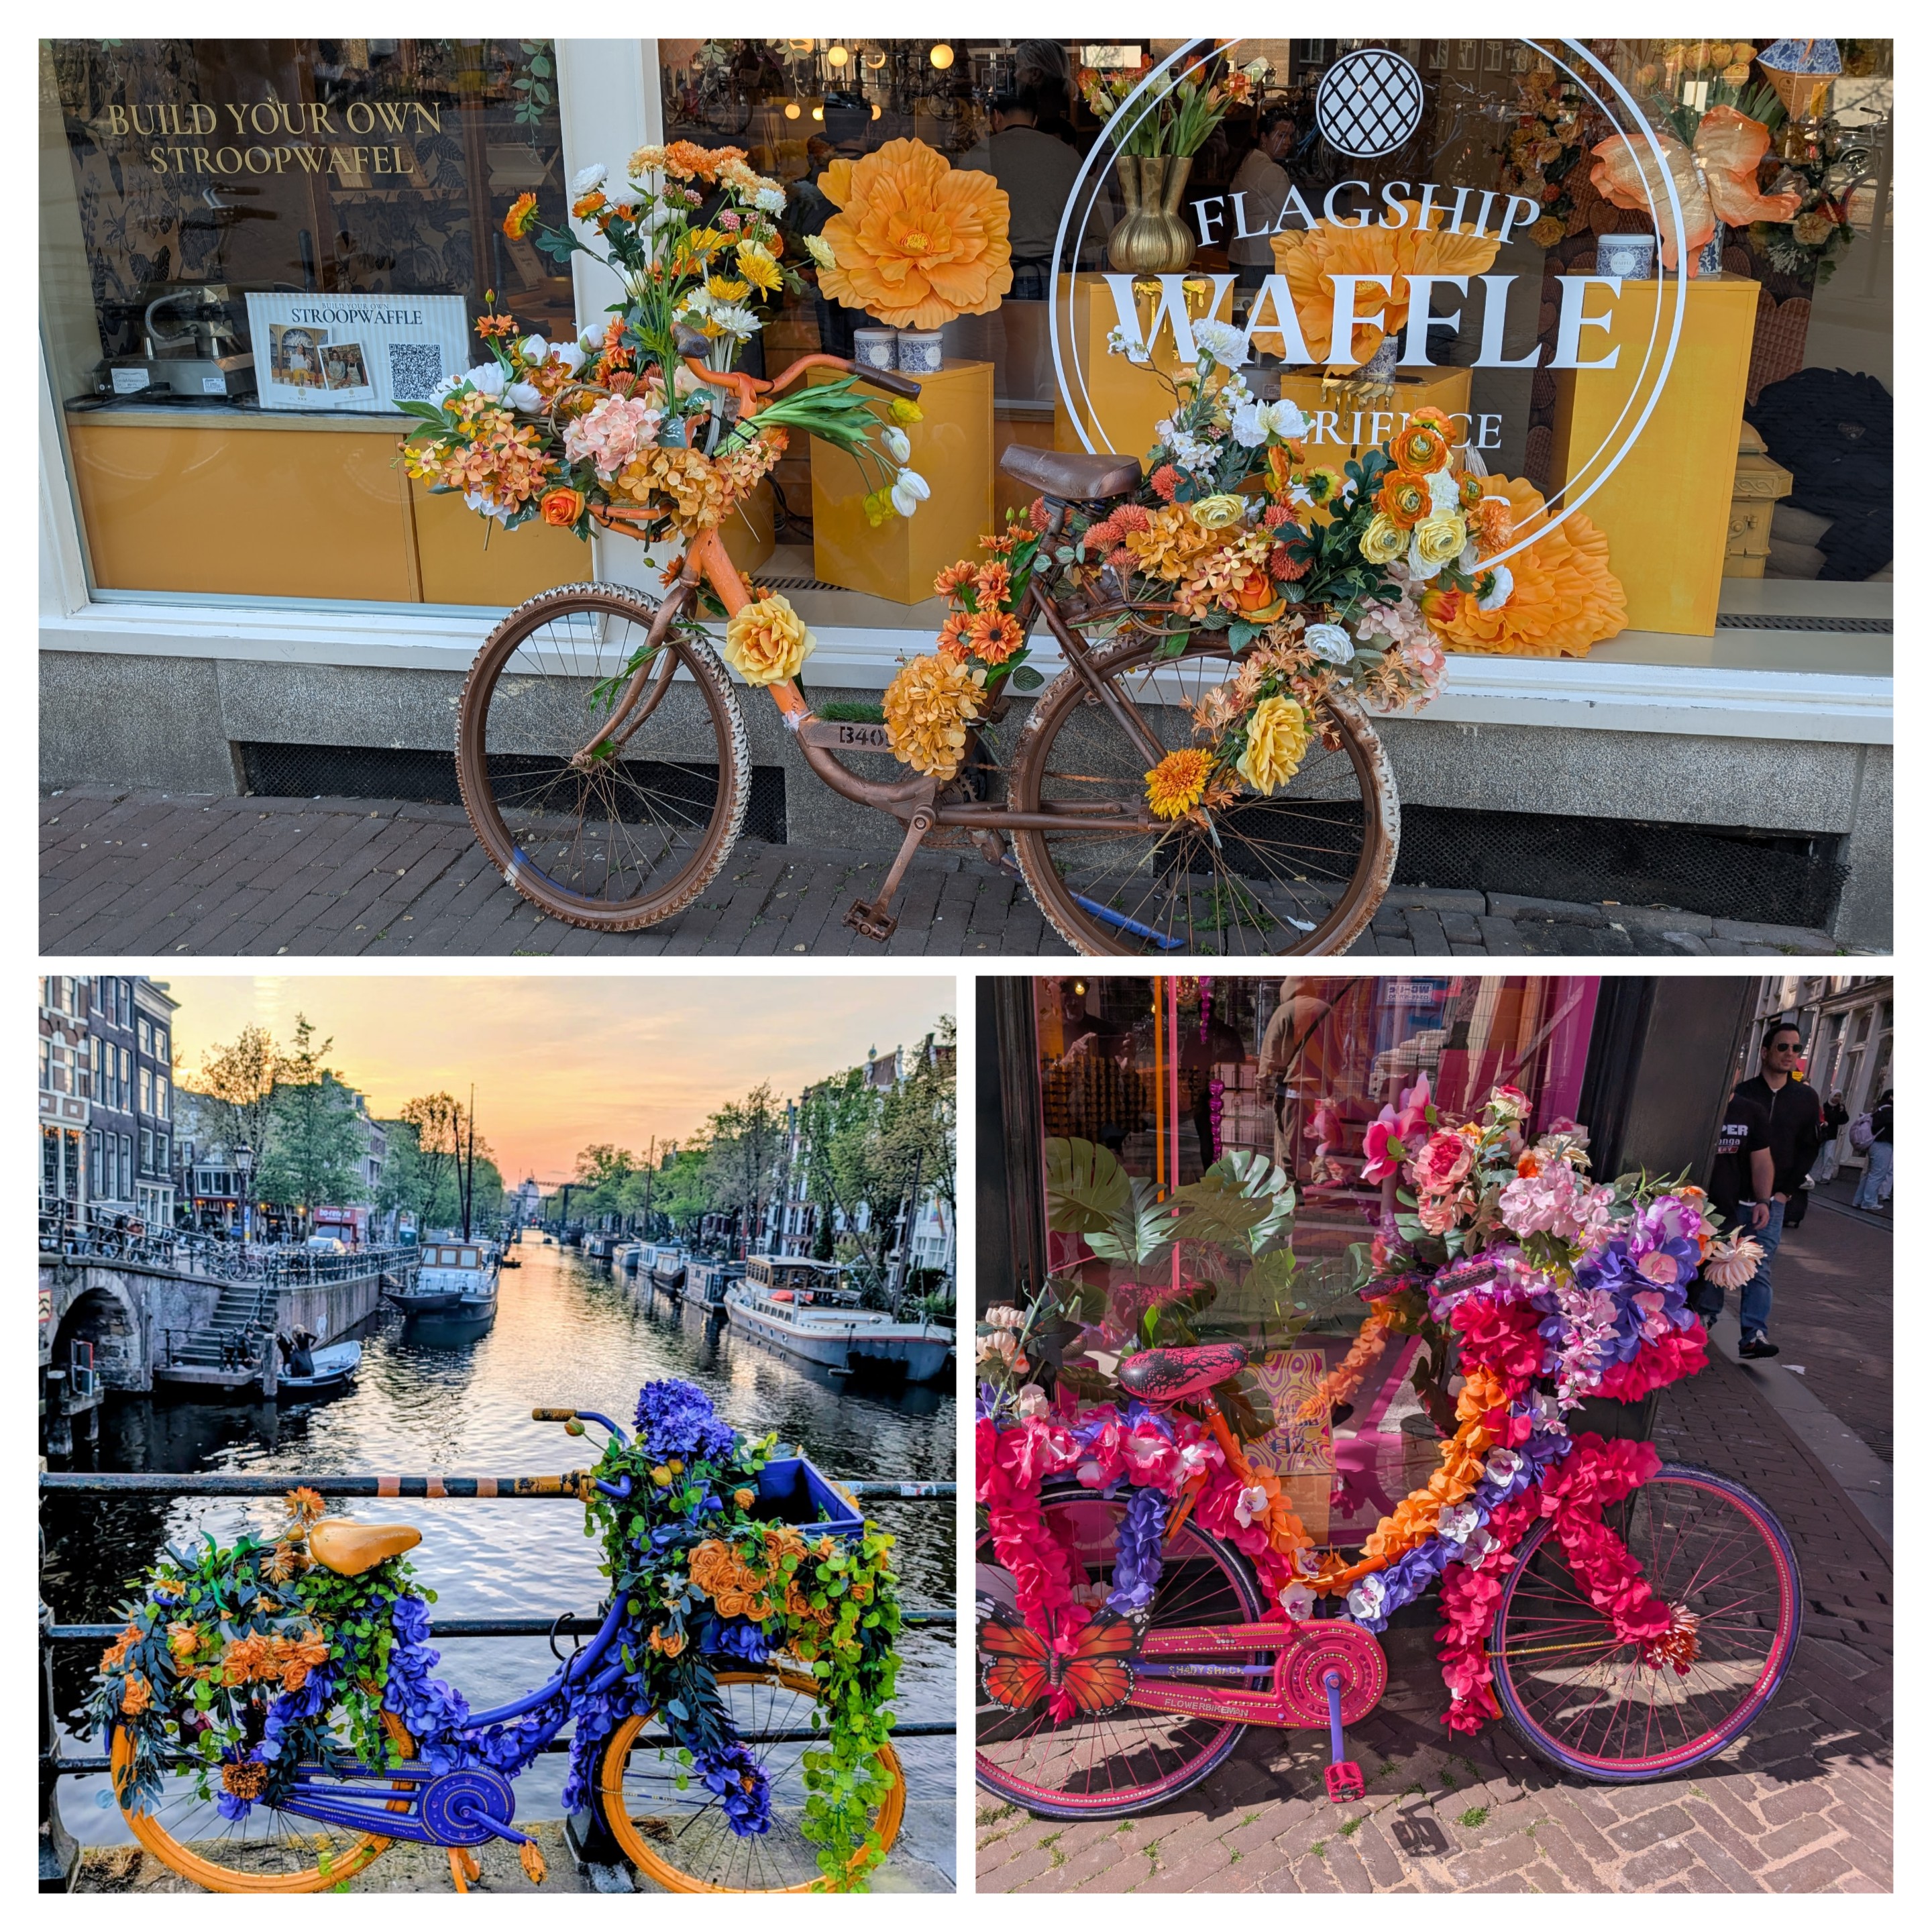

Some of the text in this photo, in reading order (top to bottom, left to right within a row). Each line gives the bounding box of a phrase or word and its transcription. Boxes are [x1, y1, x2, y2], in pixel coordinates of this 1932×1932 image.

[106, 102, 441, 135] BUILD YOUR OWN
[150, 146, 414, 174] STROOPWAFEL
[1189, 180, 1540, 248] FLAGSHIP
[292, 308, 423, 325] STROOPWAFFLE
[1103, 274, 1623, 369] WAFFLE
[1303, 411, 1502, 449] RIECE
[1168, 1665, 1204, 1676] SHADY
[1164, 1697, 1250, 1717] FLOWERBIKEMAN
